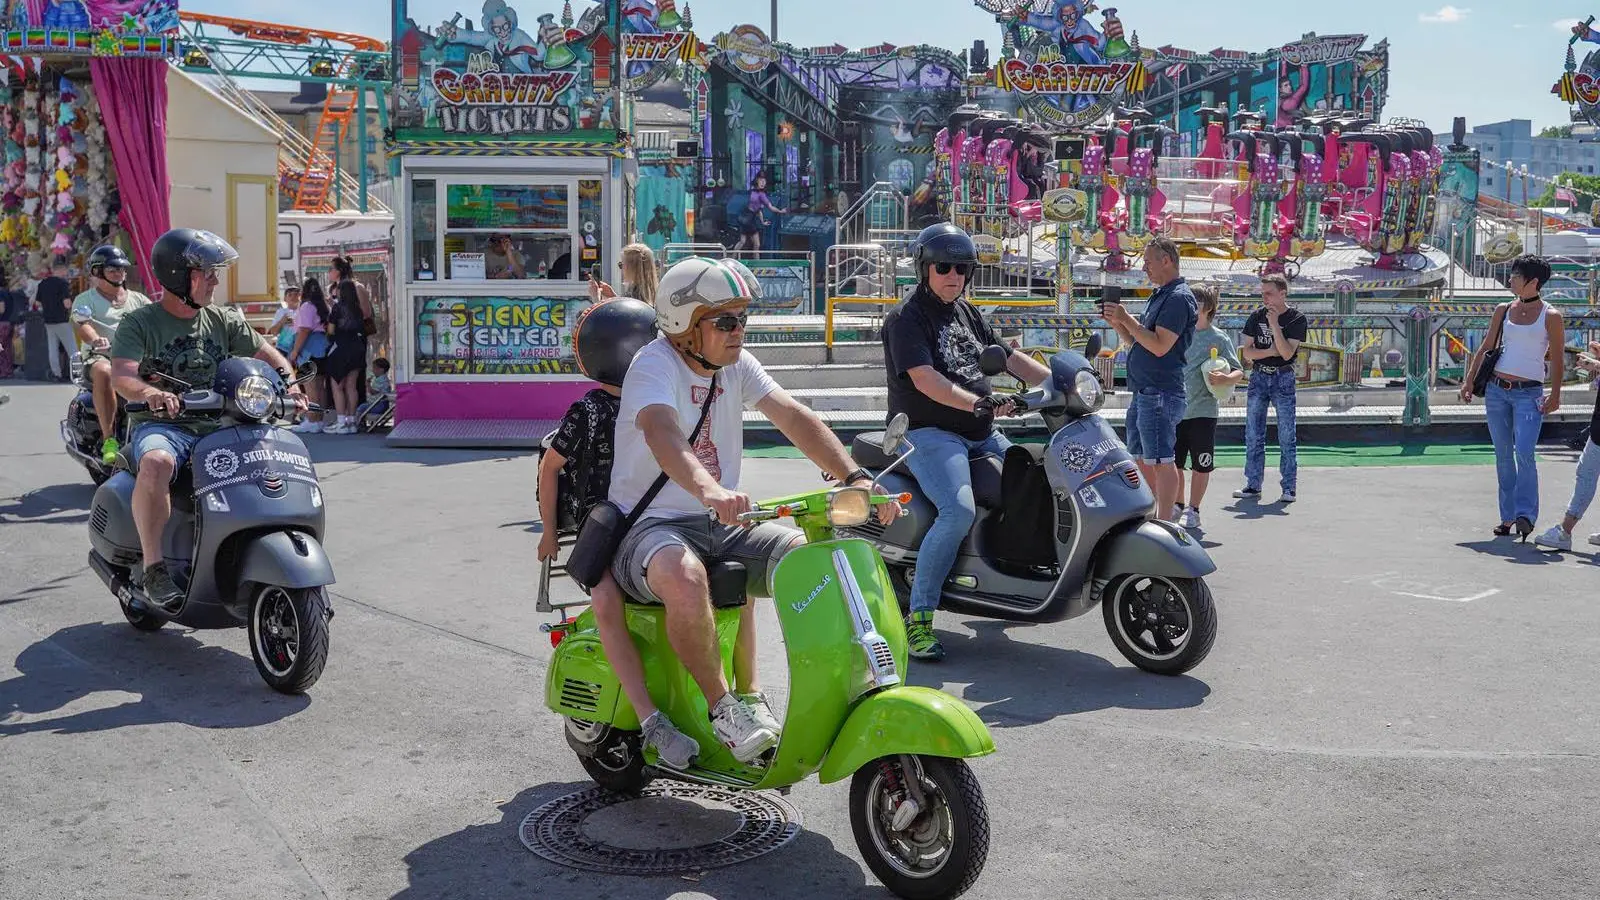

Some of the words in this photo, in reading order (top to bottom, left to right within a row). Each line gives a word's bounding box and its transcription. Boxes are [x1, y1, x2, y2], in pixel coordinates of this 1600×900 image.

[1036, 43, 1066, 64] MR.
[1280, 34, 1368, 65] GRAVITY
[467, 51, 499, 74] MR.
[431, 67, 580, 106] GRAVITY
[1004, 59, 1137, 94] GRAVITY
[436, 105, 573, 135] TICKETS
[450, 303, 566, 328] SCIENCE
[458, 327, 559, 347] CENTER
[519, 347, 561, 358] WARNER
[242, 450, 309, 467] SKULL-SCOOTERS
